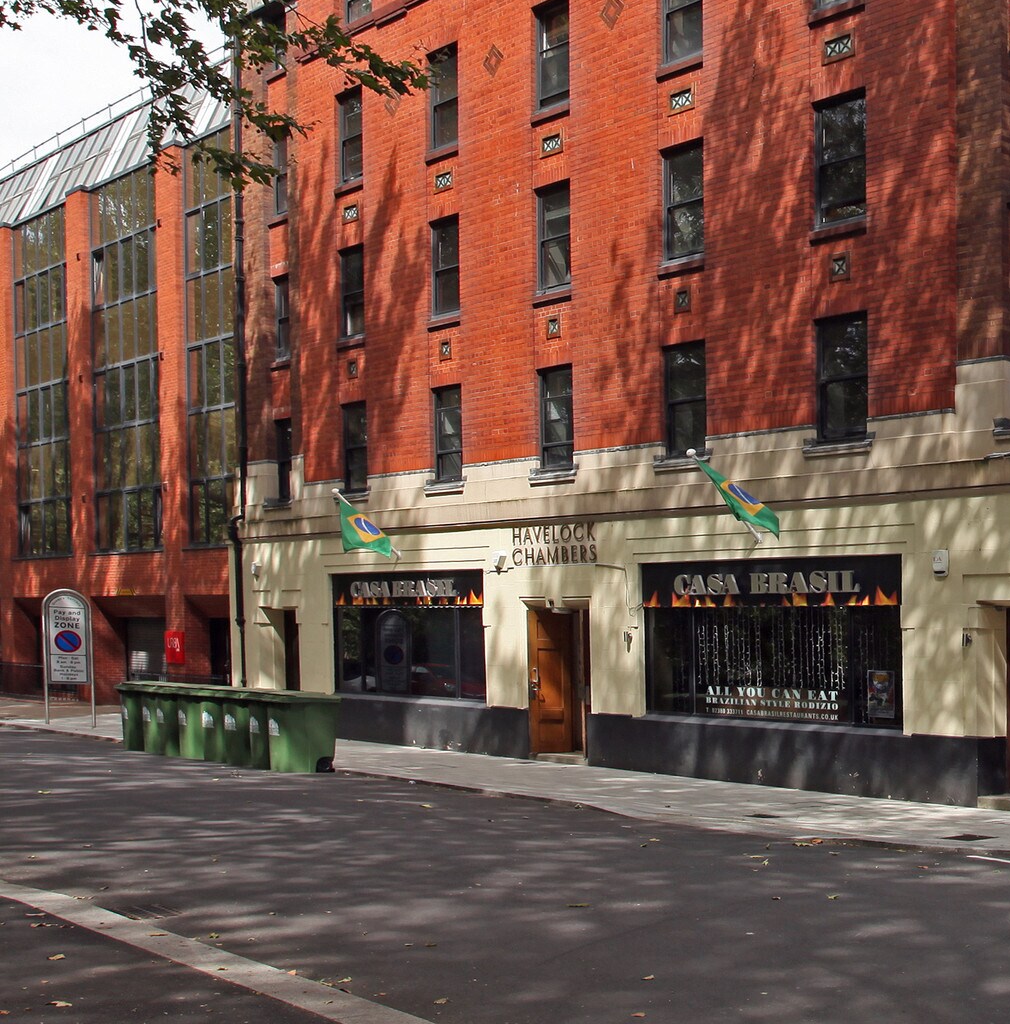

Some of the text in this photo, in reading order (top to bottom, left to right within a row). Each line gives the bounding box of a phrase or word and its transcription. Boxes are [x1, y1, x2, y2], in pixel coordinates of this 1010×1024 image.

[512, 522, 596, 546] HAVELOCK
[512, 544, 598, 566] CHAMBERS
[350, 578, 458, 597] CASA BRASIL
[673, 570, 861, 595] CASA BRASIL
[706, 685, 838, 701] ALL YOU CAN EAT
[706, 697, 839, 711] BRAZILIAN STYLE RODIZIO
